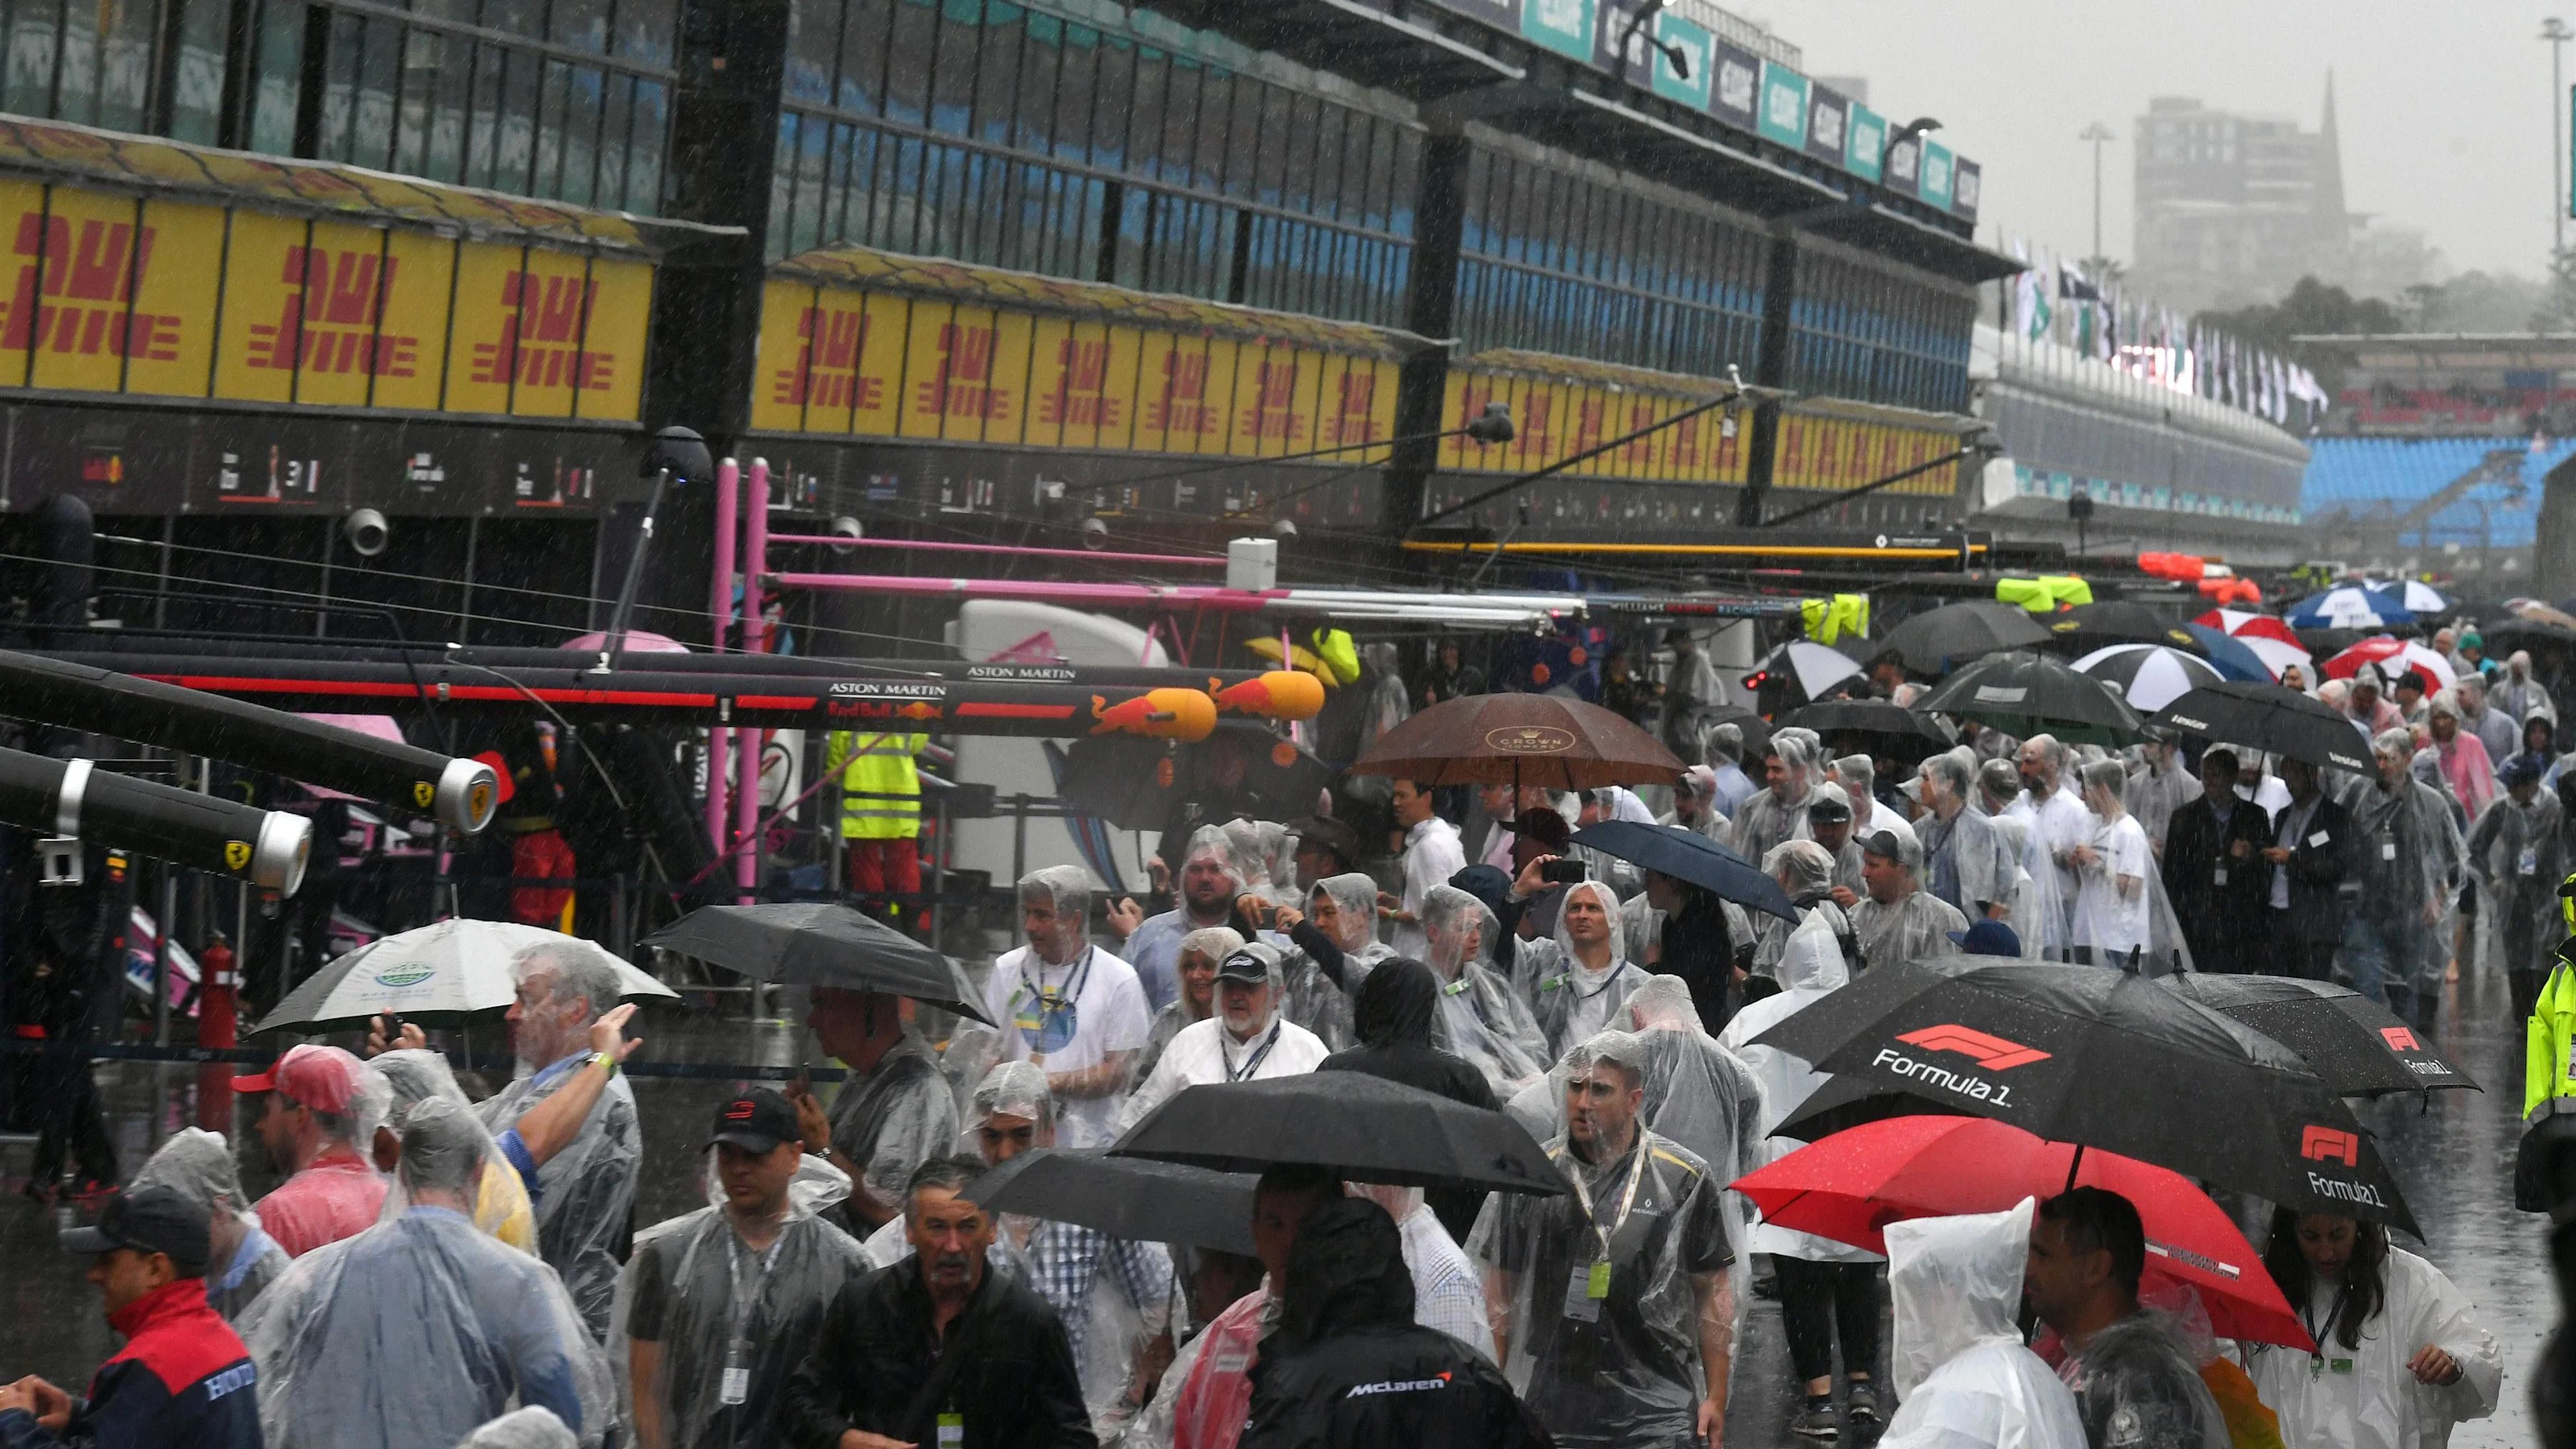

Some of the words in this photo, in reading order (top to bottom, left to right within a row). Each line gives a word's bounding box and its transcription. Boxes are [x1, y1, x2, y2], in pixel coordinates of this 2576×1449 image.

[968, 667, 1014, 677] ASTON
[1018, 668, 1075, 679] MARTIN
[829, 683, 880, 694] ASTON
[885, 685, 947, 696] MARTIN
[1346, 1378, 1445, 1398] McLaren
